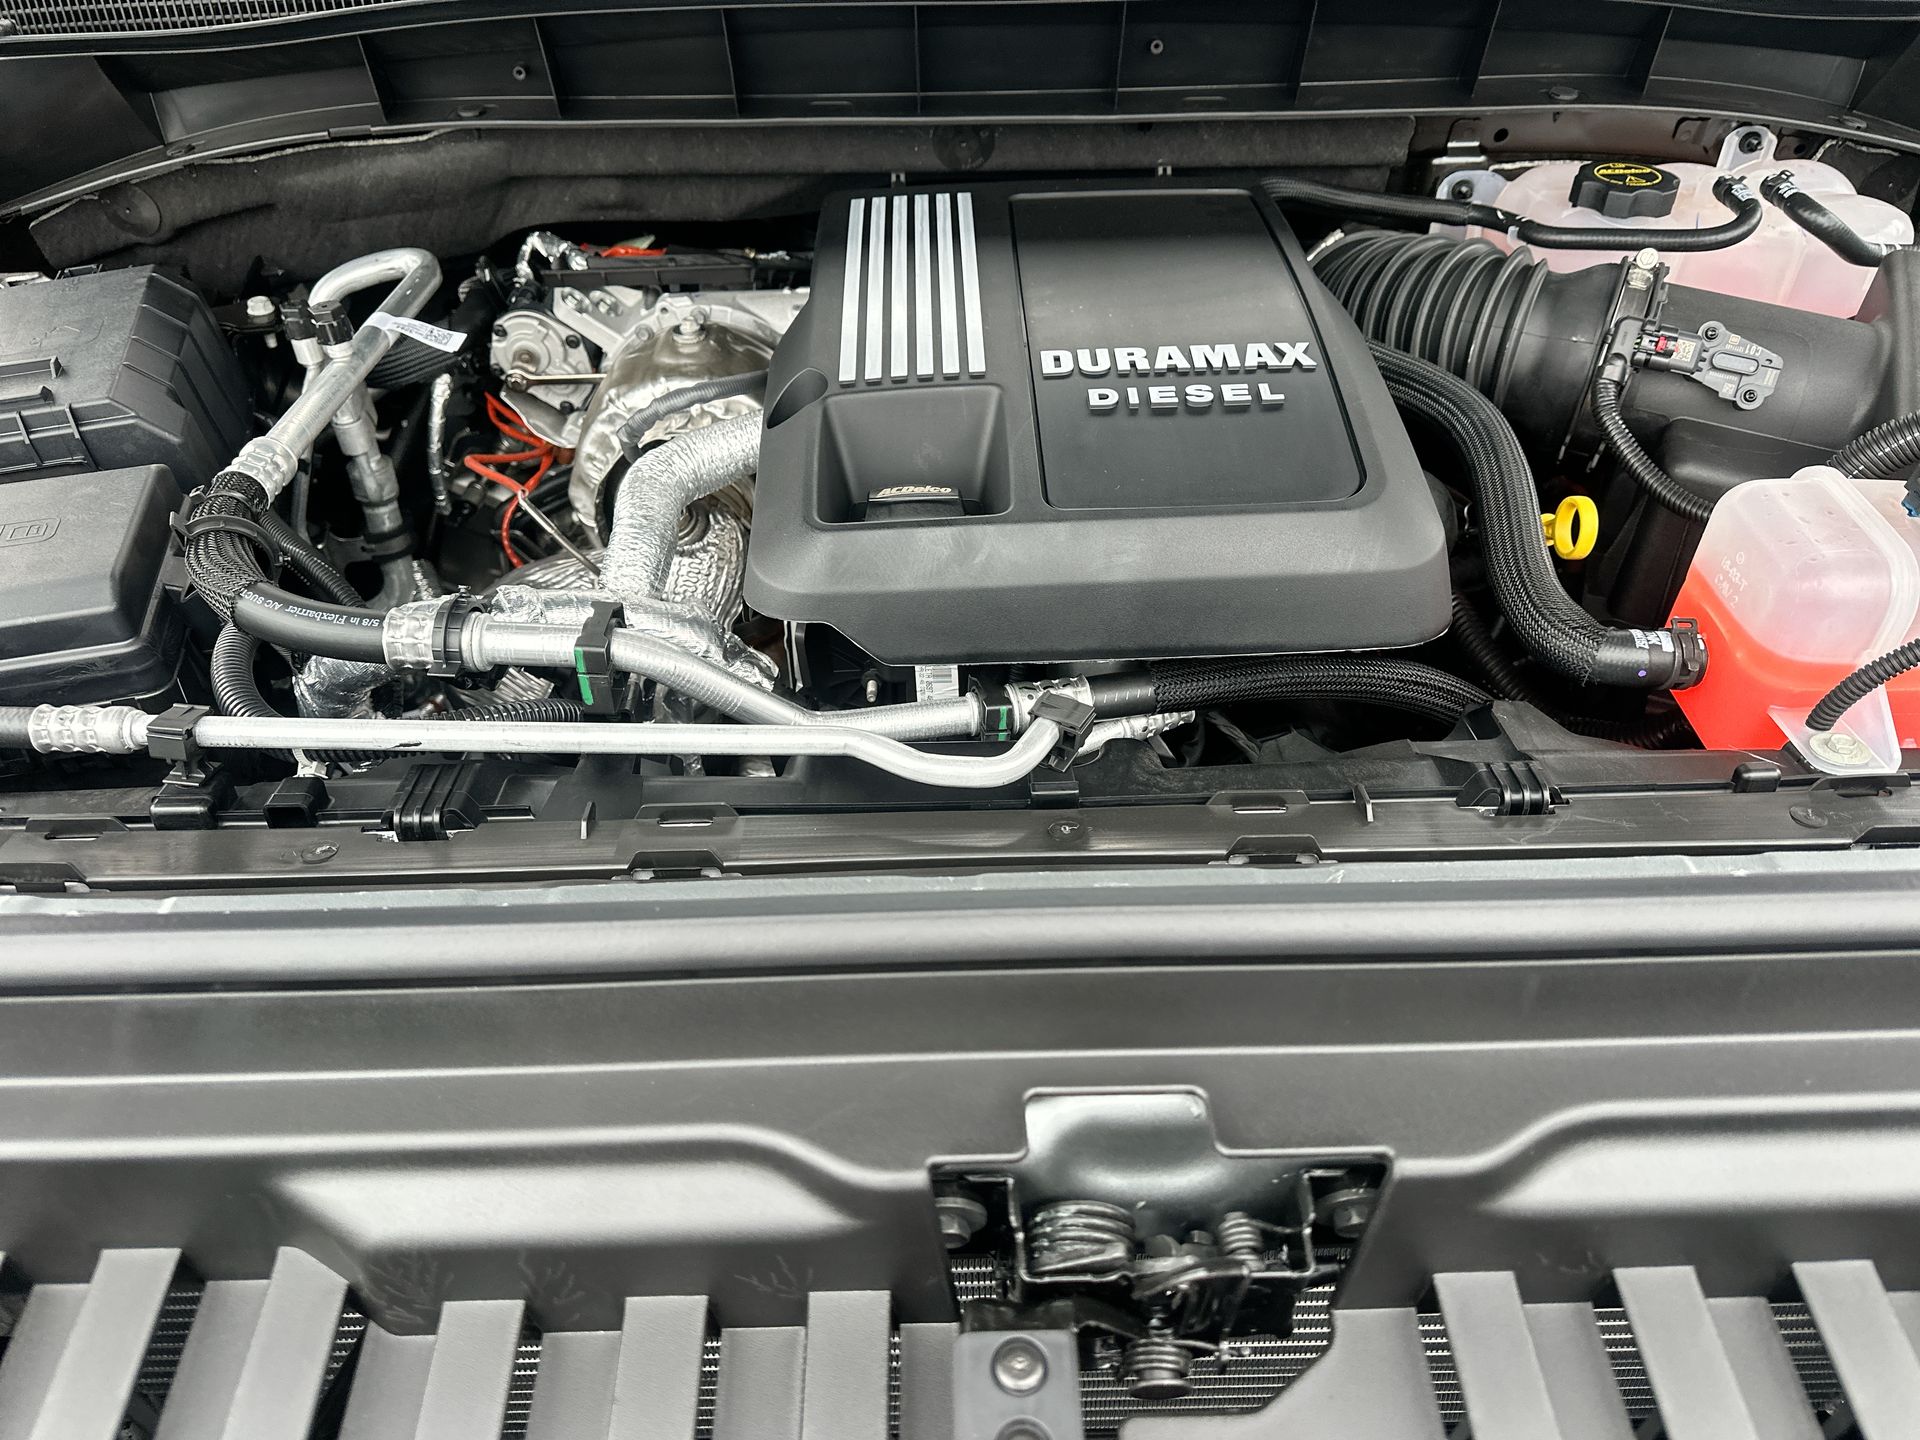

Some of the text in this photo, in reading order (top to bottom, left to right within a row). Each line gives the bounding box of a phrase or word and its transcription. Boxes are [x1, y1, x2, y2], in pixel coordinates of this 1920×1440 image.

[1040, 341, 1318, 377] DURAMAX
[1087, 382, 1286, 410] DIESEL
[876, 485, 952, 498] ACDelco
[264, 600, 284, 611] A/C
[285, 605, 348, 625] Flexbarrier
[362, 617, 381, 627] 5/8
